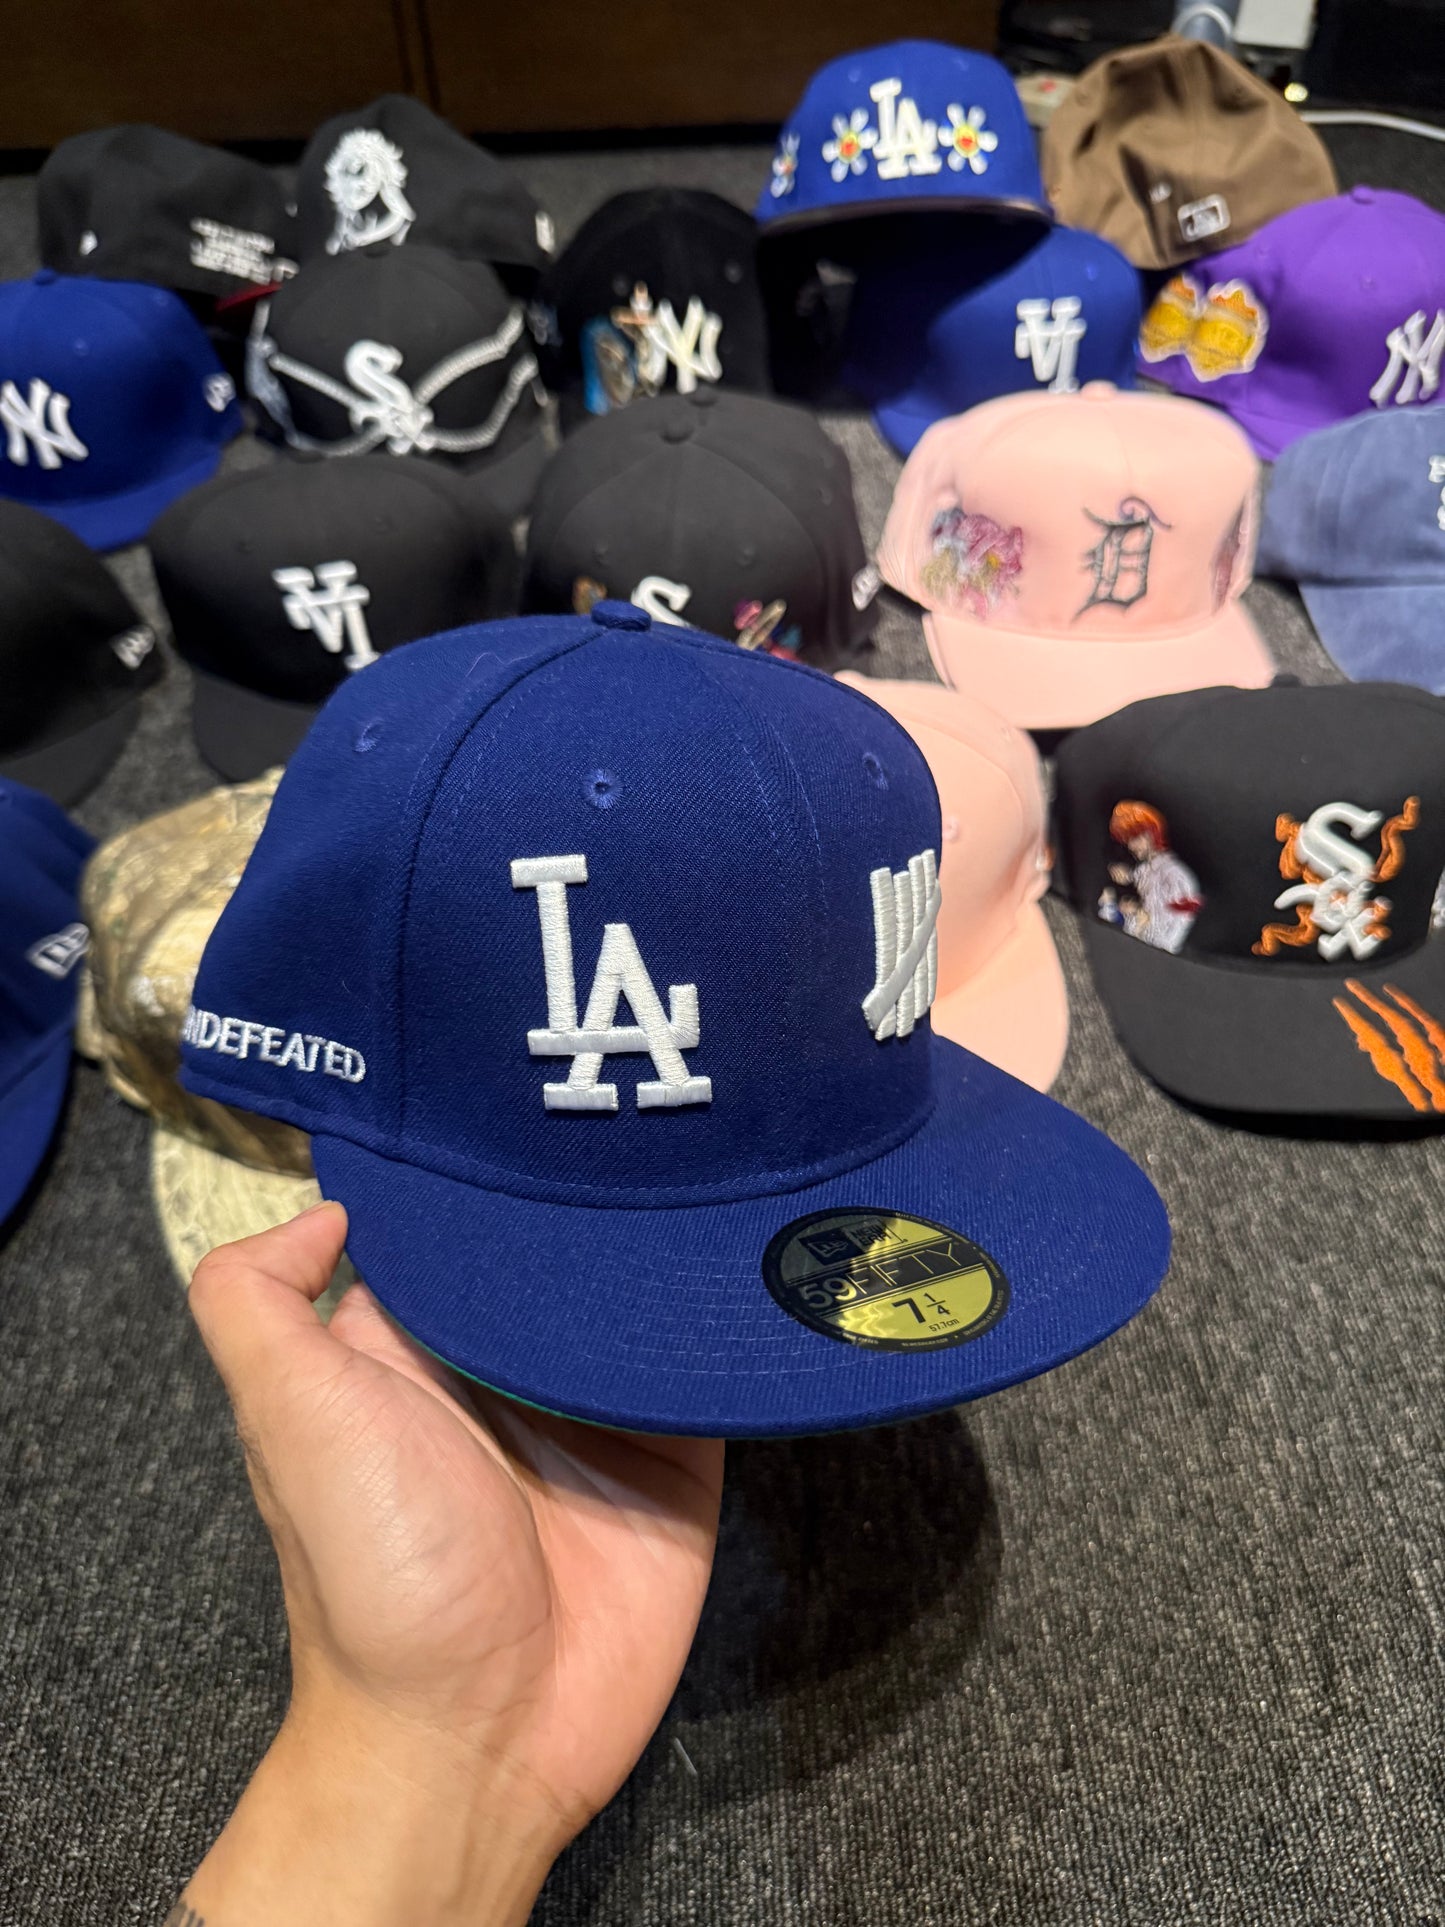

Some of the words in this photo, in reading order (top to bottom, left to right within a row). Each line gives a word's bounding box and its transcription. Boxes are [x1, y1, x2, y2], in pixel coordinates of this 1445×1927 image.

[869, 77, 942, 180] LA
[640, 294, 722, 394] NY
[0, 377, 89, 469] NY
[511, 854, 712, 1111] LA
[183, 1004, 366, 1084] NDEFEATED
[801, 1243, 961, 1309] 59FIFTY
[928, 1318, 960, 1333] 57.7cm
